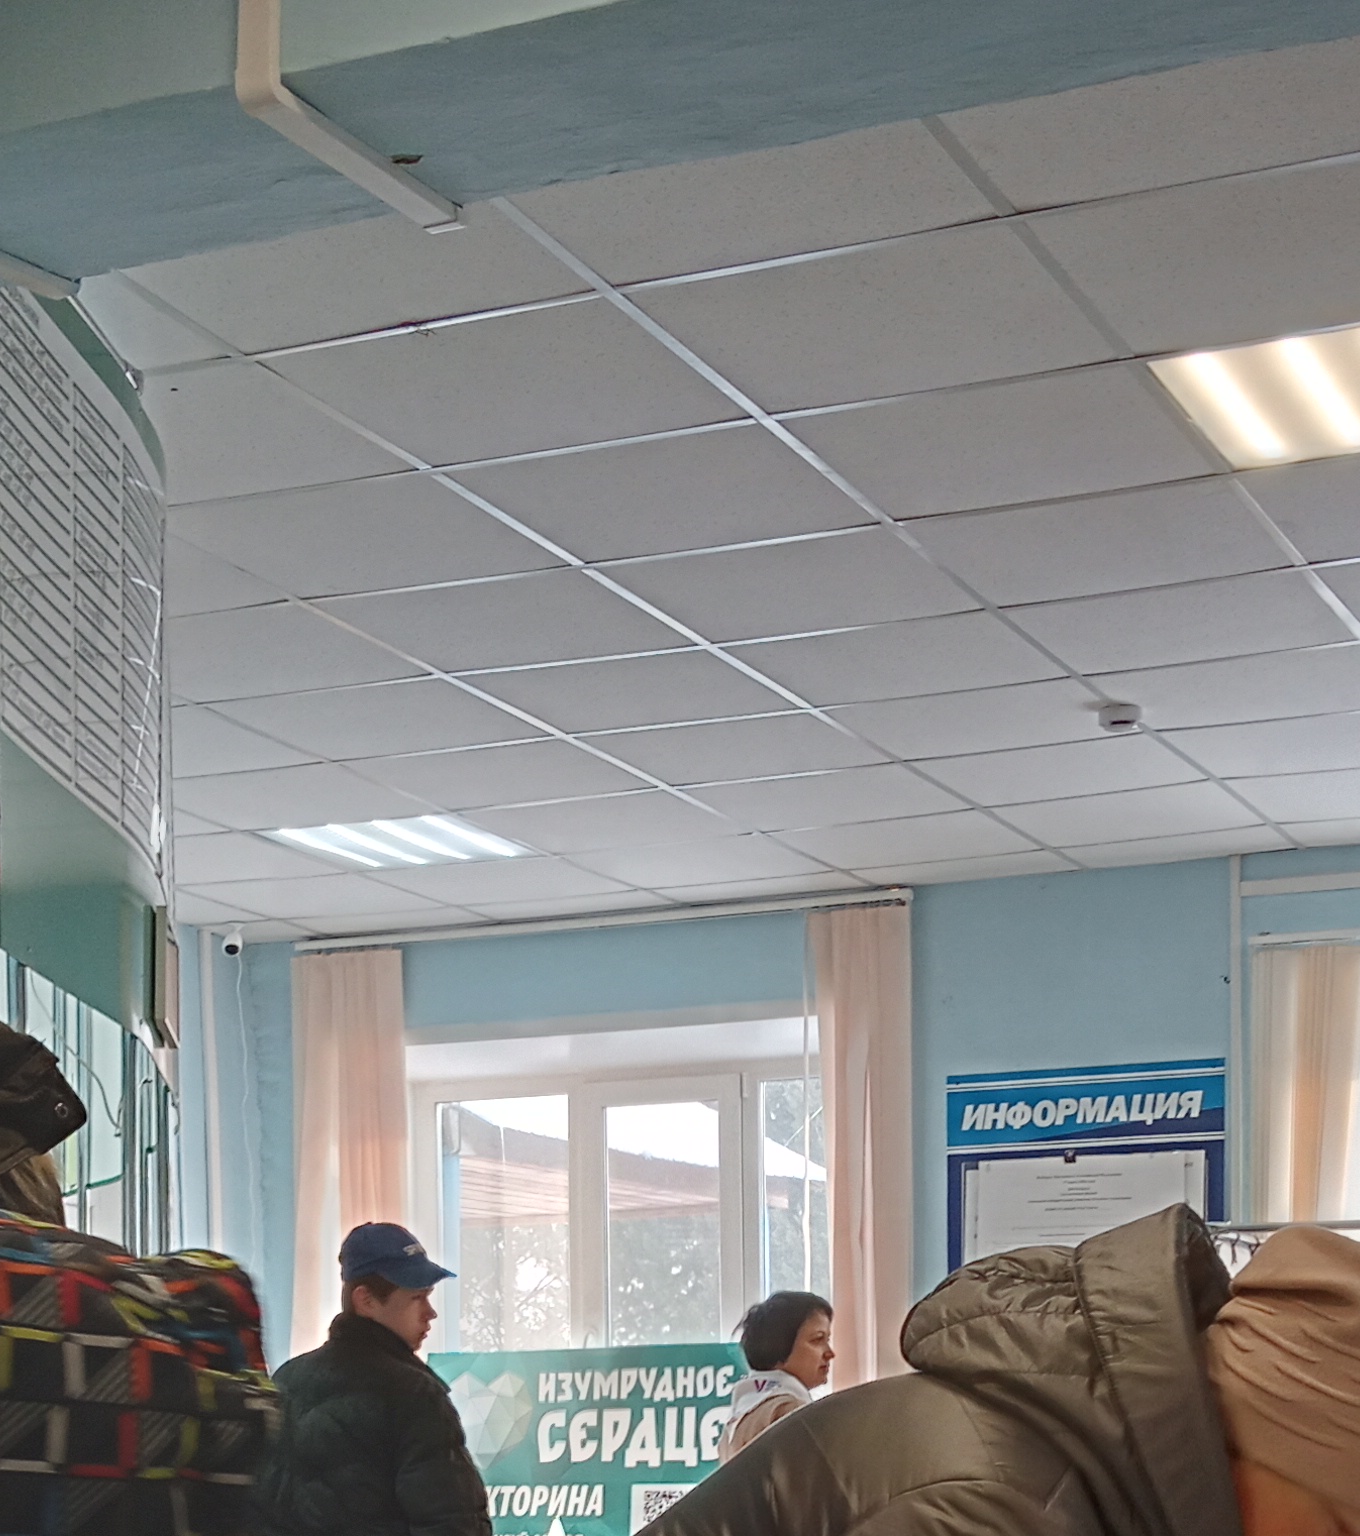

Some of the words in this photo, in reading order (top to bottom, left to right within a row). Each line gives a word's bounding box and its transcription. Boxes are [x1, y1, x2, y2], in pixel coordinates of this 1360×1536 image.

[961, 1090, 1204, 1131] ИНФОРМАЦИЯ
[537, 1364, 736, 1402] ИЗУМРУДНОЕ
[537, 1406, 732, 1469] СЕРДЦЕ
